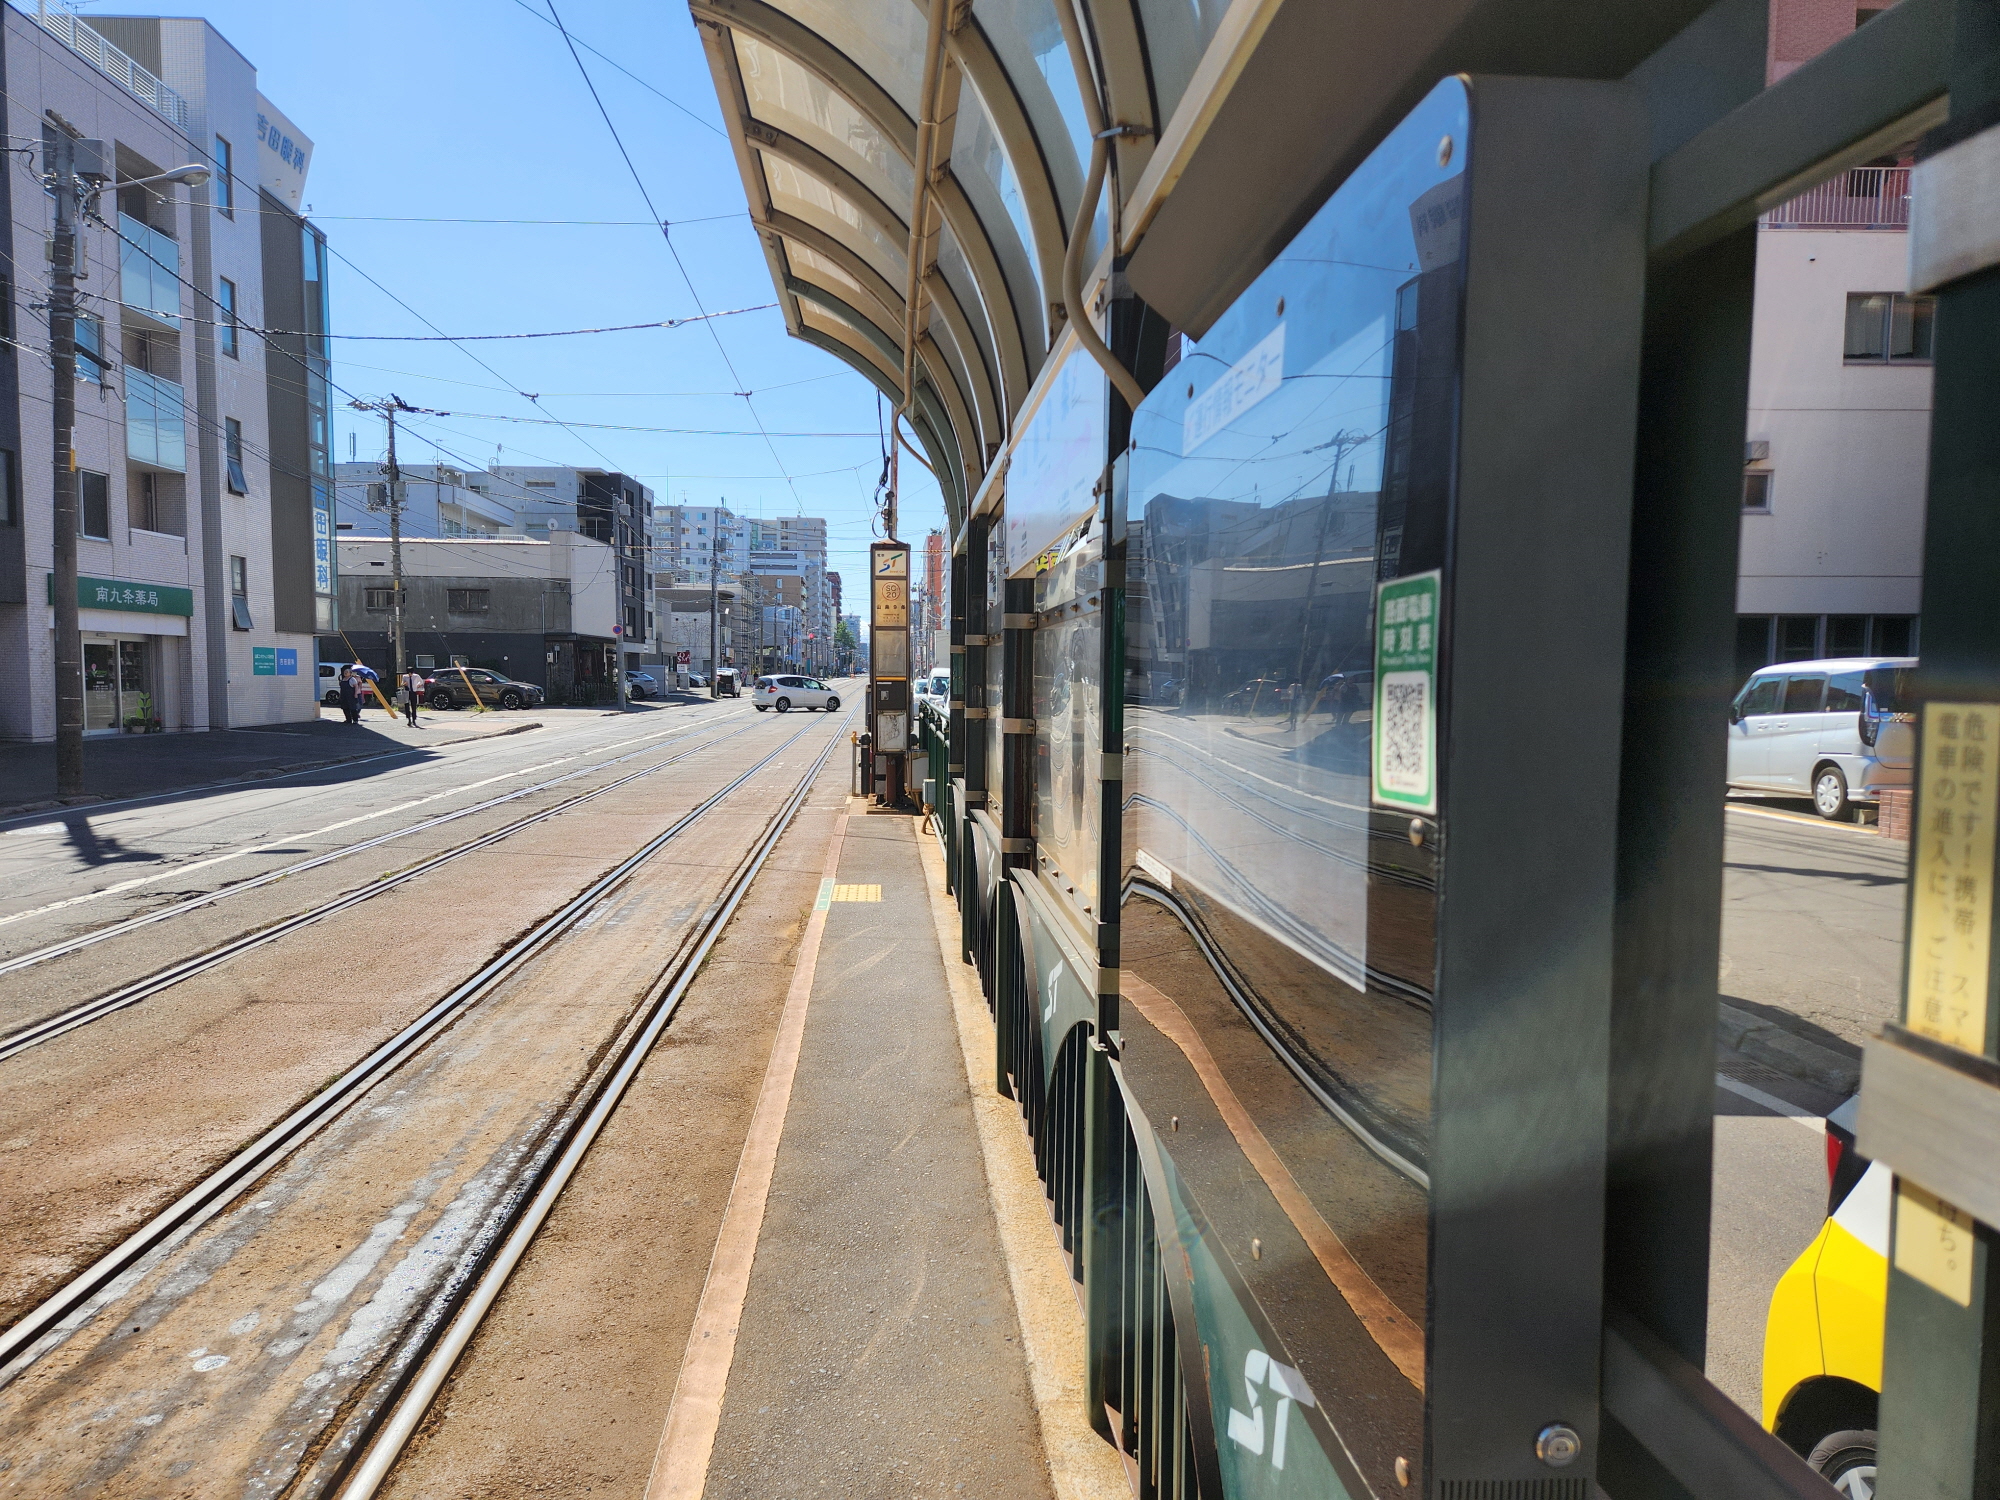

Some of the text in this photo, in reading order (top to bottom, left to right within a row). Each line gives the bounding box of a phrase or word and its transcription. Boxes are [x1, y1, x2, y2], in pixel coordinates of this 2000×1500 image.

[314, 484, 329, 589] 吉田眼科
[96, 586, 158, 607] 南九条薬局
